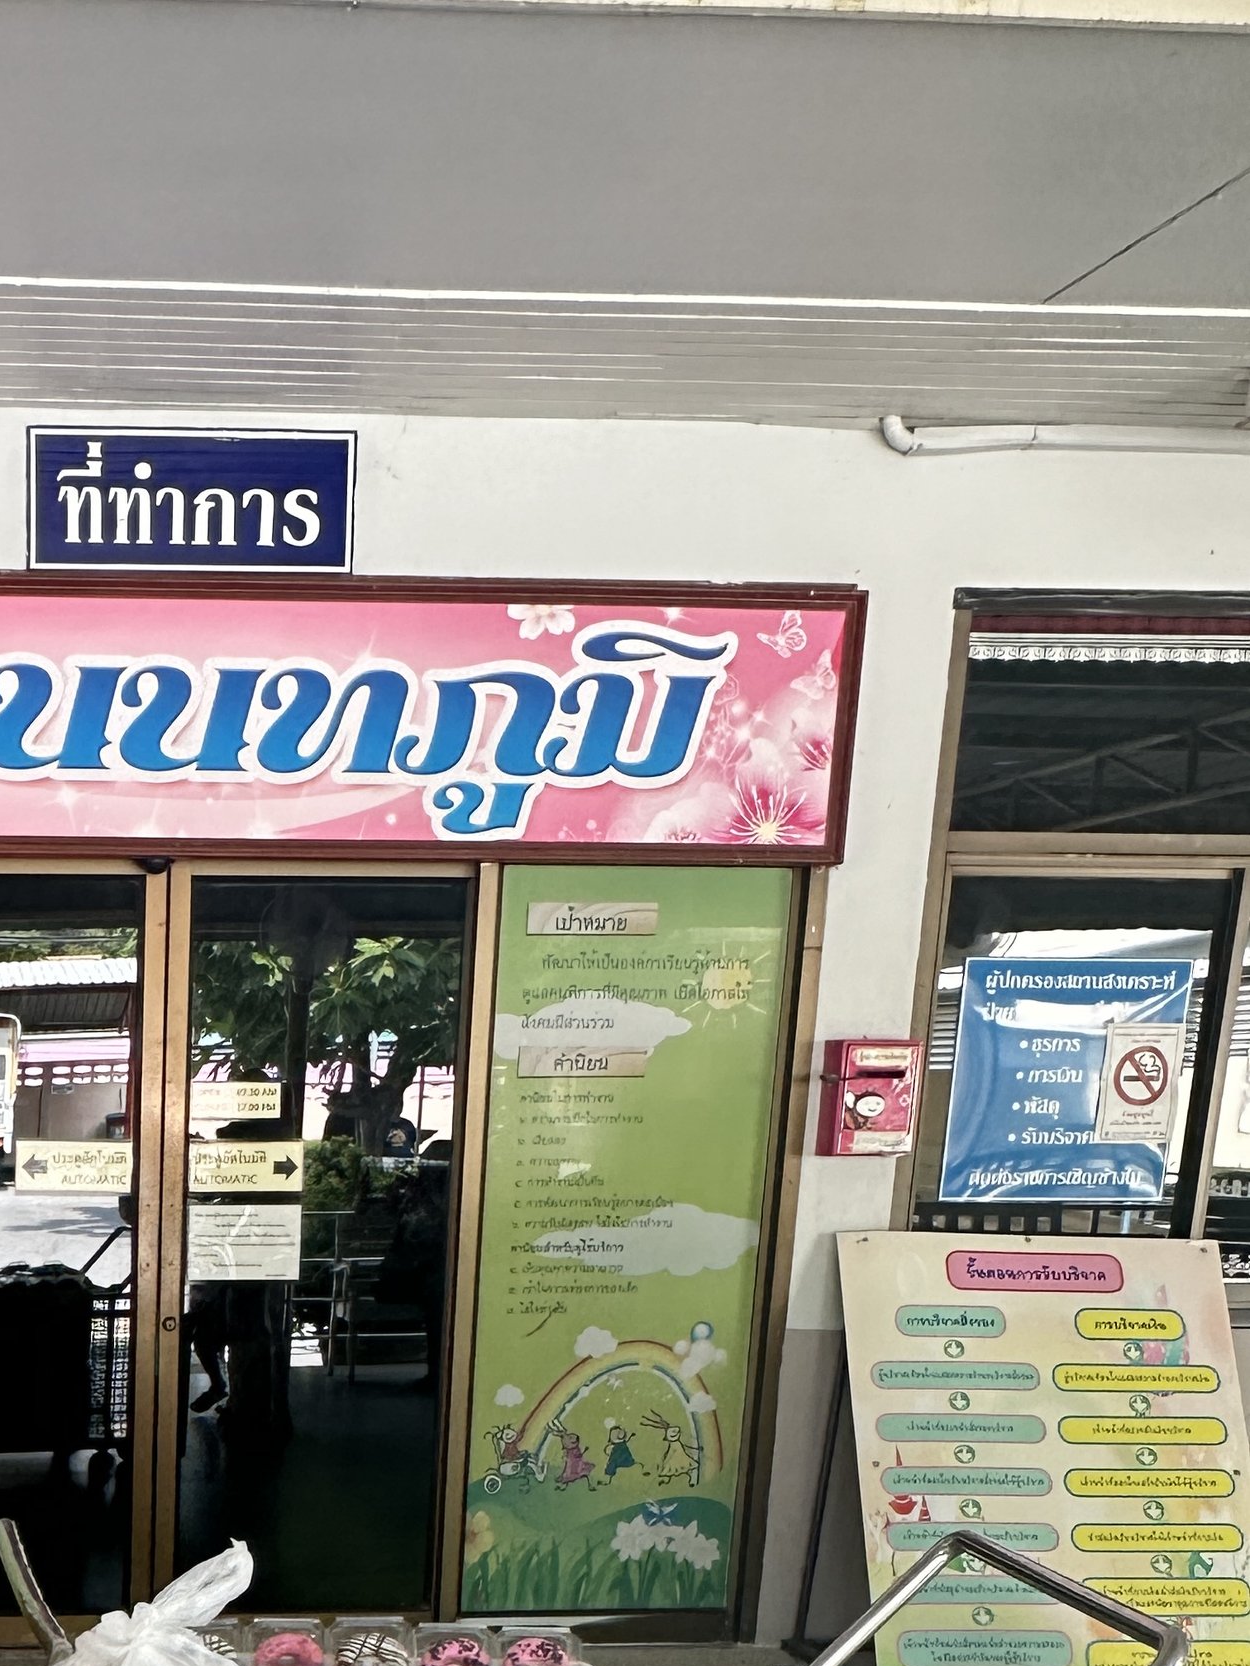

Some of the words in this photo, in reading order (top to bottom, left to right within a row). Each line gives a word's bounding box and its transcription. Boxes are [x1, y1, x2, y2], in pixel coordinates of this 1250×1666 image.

[58, 440, 321, 550] ที่ทำการ
[555, 906, 628, 932] เป้าหมาย
[1032, 1037, 1081, 1058] ธุรการ
[1028, 1066, 1083, 1083] การเงิน
[1024, 1096, 1060, 1119] พัสดุ
